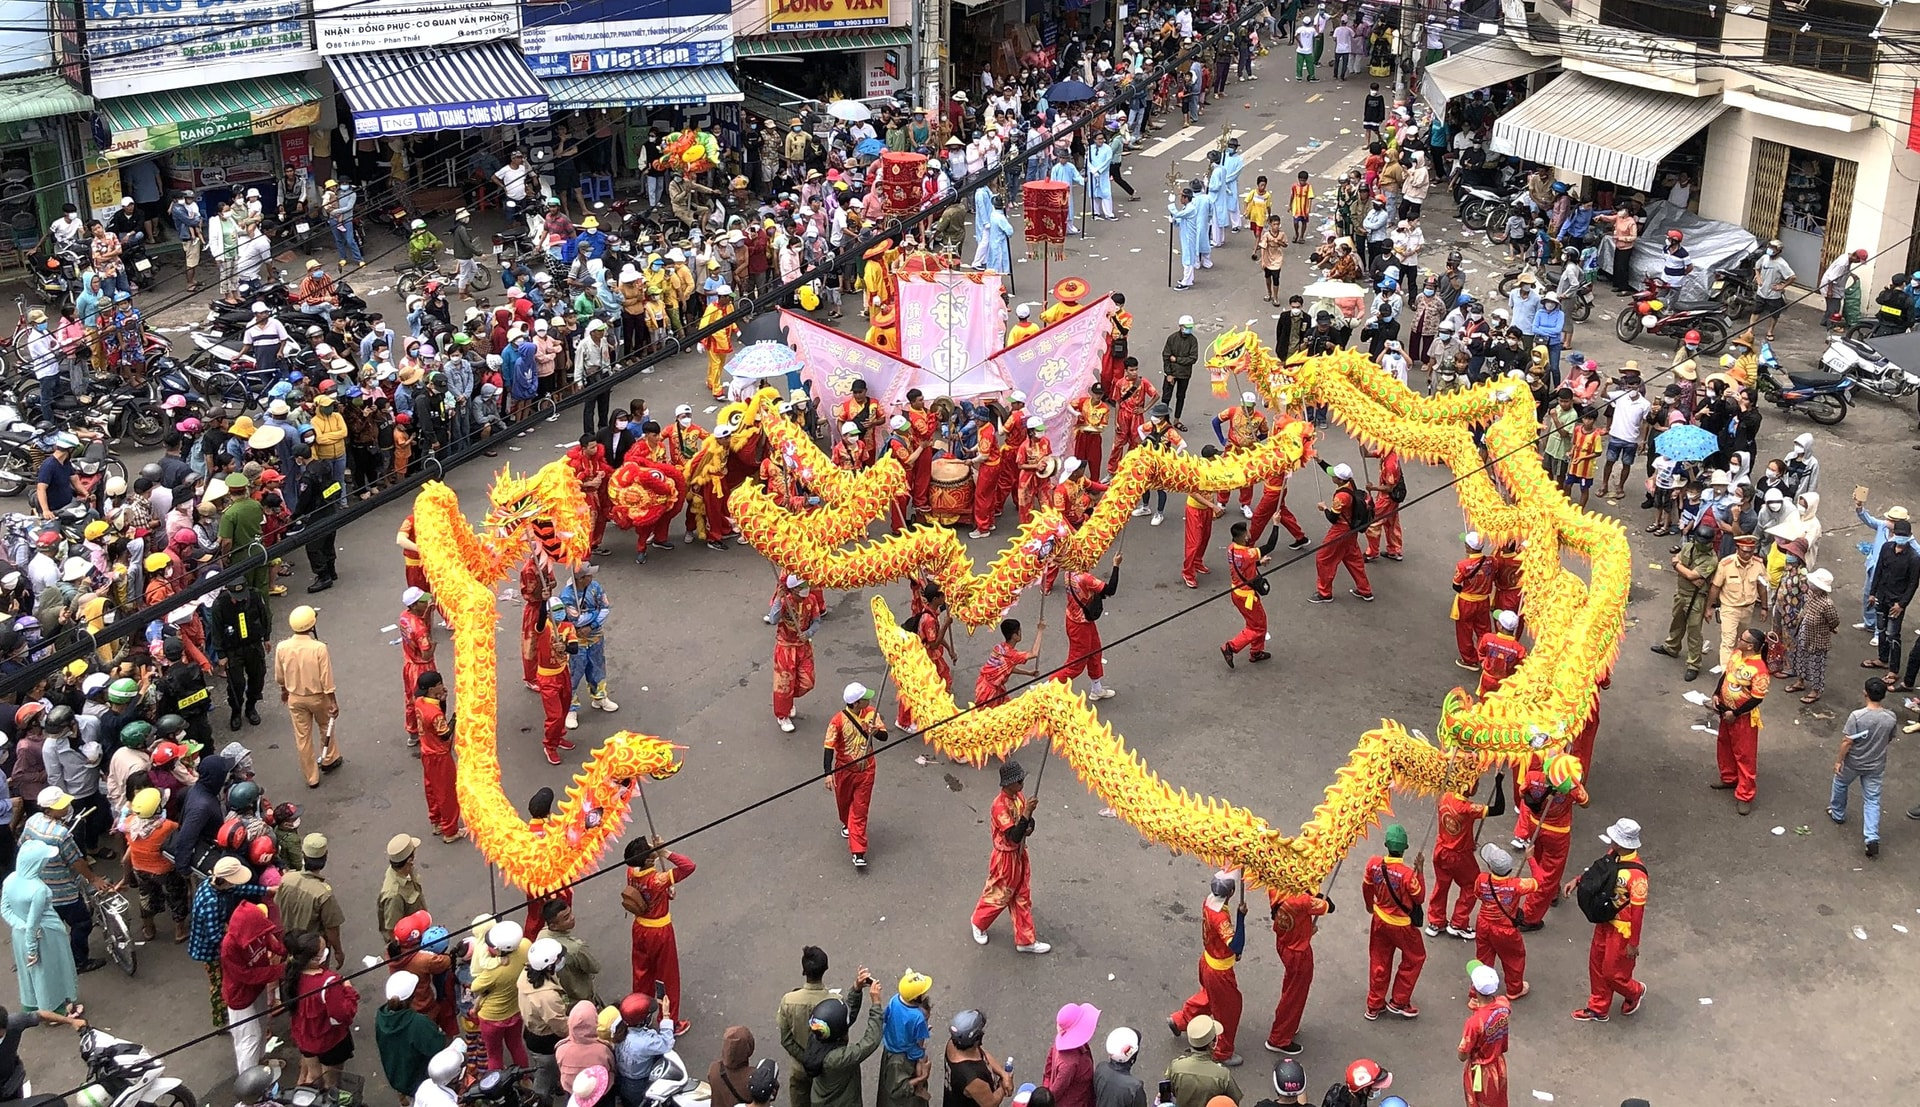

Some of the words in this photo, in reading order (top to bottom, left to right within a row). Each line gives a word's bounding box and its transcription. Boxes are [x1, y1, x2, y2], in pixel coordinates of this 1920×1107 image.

[384, 118, 413, 129] TNG
[438, 106, 468, 127] TRANG
[467, 104, 492, 124] CÔNG
